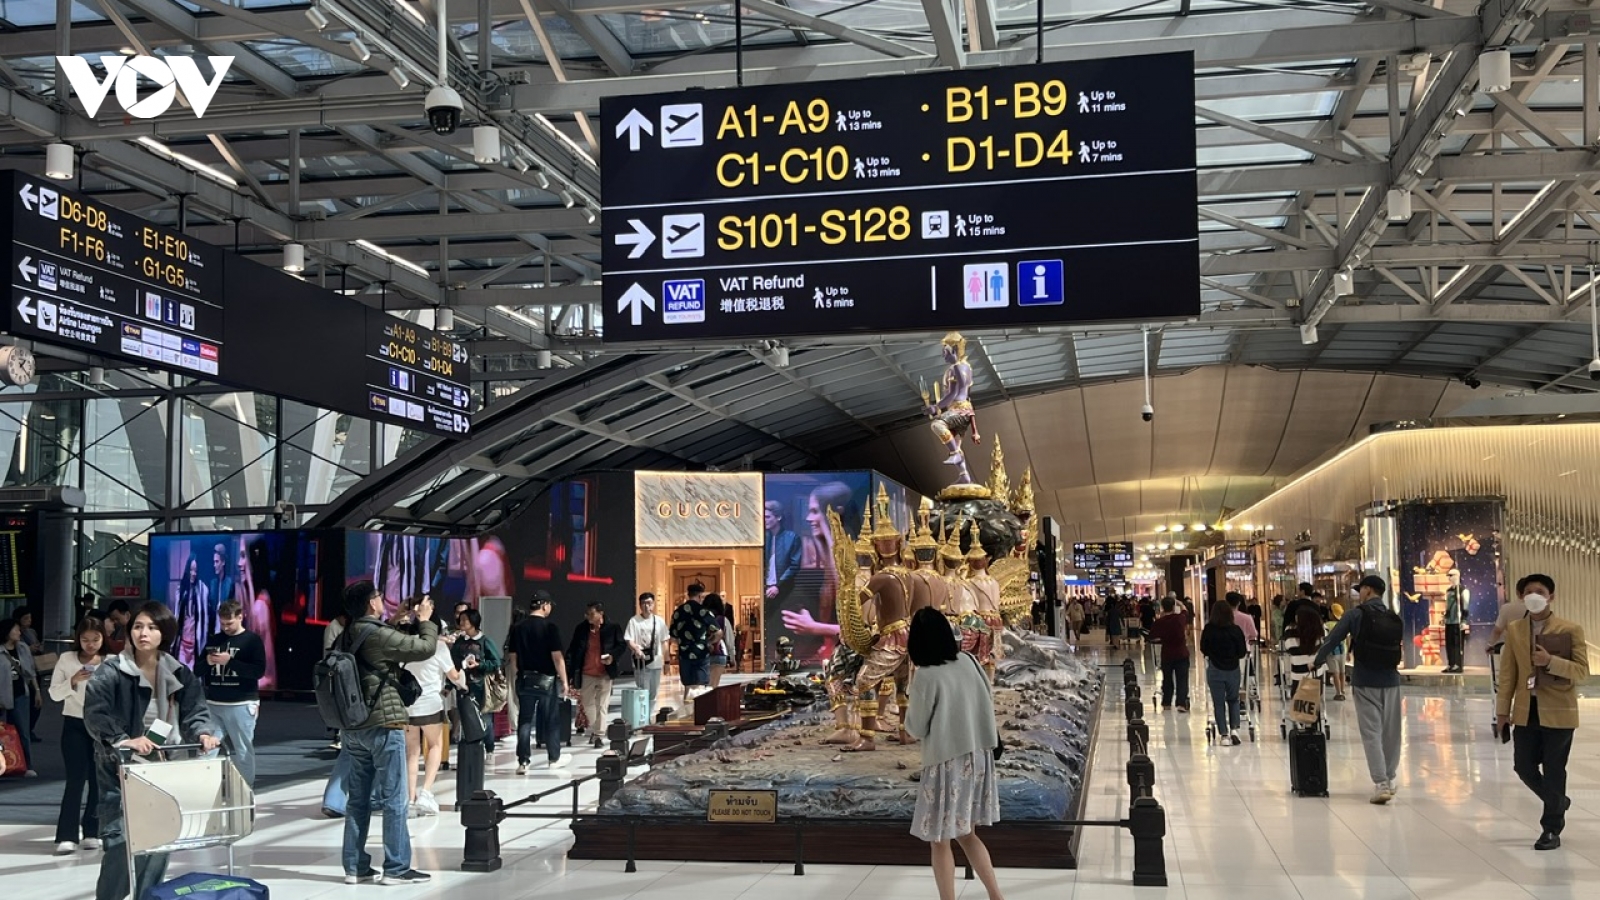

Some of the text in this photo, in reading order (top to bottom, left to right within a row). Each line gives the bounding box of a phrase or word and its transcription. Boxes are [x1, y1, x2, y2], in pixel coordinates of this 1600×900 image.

[946, 80, 1067, 123] B1-B9
[1091, 90, 1115, 102] Up to
[1091, 102, 1126, 112] 11 mins
[716, 98, 830, 140] A1-A9
[848, 110, 871, 120] Up to
[849, 120, 882, 131] 13 mins
[947, 129, 1073, 173] D1-D4
[1092, 140, 1116, 151] Up to
[866, 156, 889, 168] Up to
[1092, 152, 1122, 162] 7 mins
[716, 145, 849, 188] C1-C10
[867, 167, 900, 178] 13 mins
[61, 195, 106, 231] D6-D8
[968, 214, 994, 225] Up to
[717, 206, 911, 250] S101-S128
[969, 226, 1006, 236] 15 mins
[60, 227, 104, 261] F1-F6
[144, 227, 187, 260] E1-E10
[40, 263, 56, 276] VAT
[60, 266, 71, 277] VAT
[144, 256, 184, 287] G1-G5
[720, 274, 805, 292] VAT Refund
[668, 284, 700, 300] VAT
[825, 286, 849, 296] Up to
[668, 301, 701, 311] REFUND
[834, 298, 854, 307] mins
[658, 501, 741, 518] GUCCI
[712, 808, 731, 816] PLEASE
